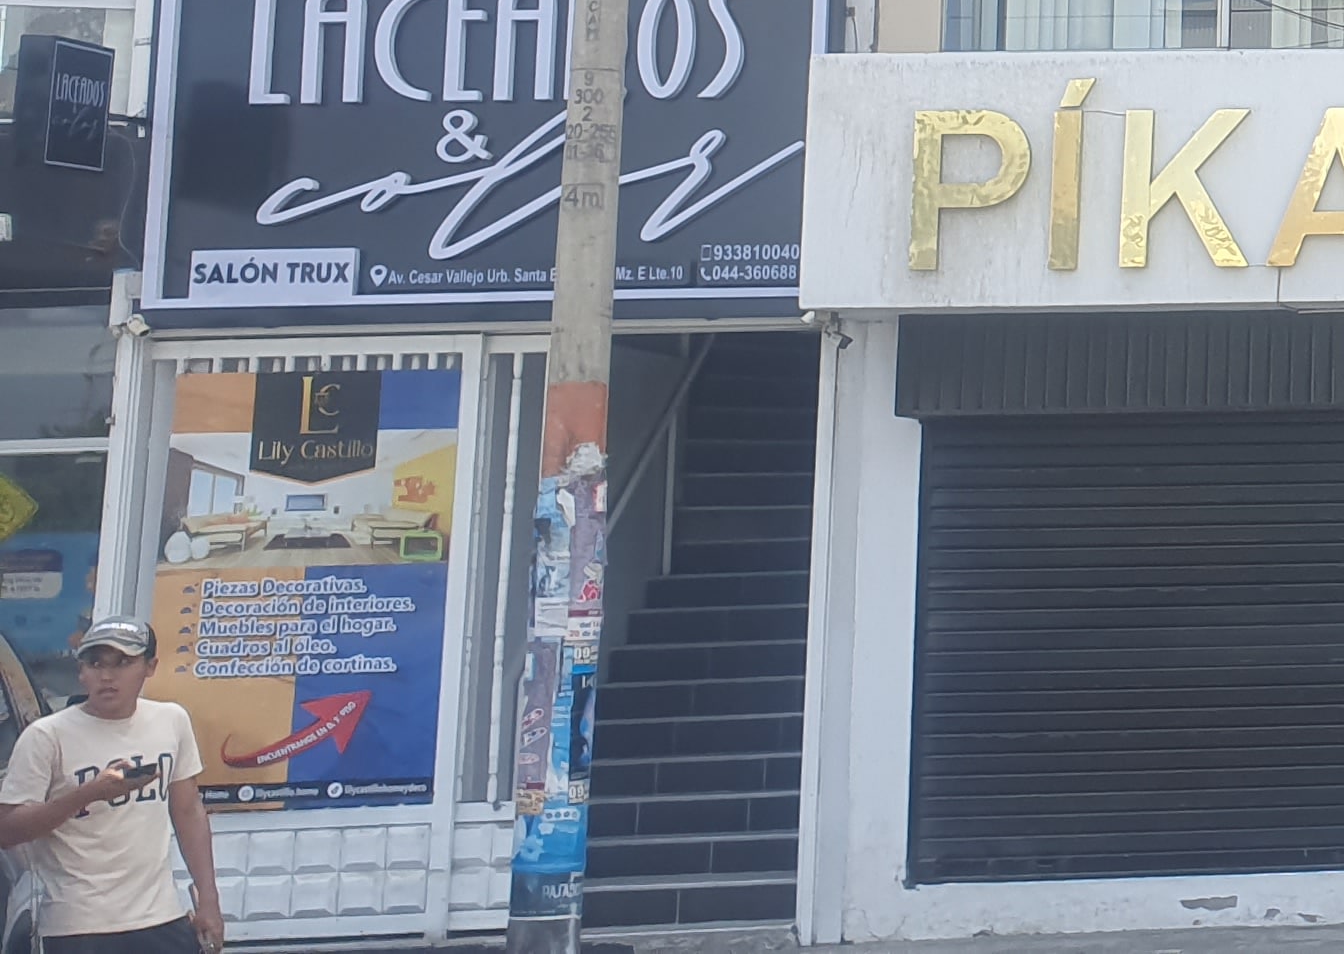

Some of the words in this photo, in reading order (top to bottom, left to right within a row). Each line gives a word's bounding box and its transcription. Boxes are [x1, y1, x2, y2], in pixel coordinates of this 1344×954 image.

[437, 111, 493, 163] &
[714, 245, 800, 261] 933810040
[193, 257, 278, 284] SALÓN
[287, 262, 350, 284] TRUX
[388, 270, 405, 285] Av.
[409, 269, 443, 284] Cesar
[445, 269, 484, 286] Vallejo
[487, 269, 510, 283] Urb.
[514, 267, 547, 282] Santa
[616, 266, 634, 280] Mz.
[712, 265, 797, 281] 044-360688
[259, 440, 294, 465] Lily
[301, 440, 374, 459] Castillo
[203, 580, 258, 596] Piezas
[262, 576, 367, 594] Decorativas.
[201, 598, 299, 615] Decoración
[302, 598, 326, 614] de
[329, 596, 416, 613] interiores.
[199, 620, 276, 637] Muebles
[277, 620, 317, 637] para
[320, 617, 338, 634] el
[340, 617, 396, 637] hogar.
[196, 639, 270, 656] Cuadros
[272, 639, 290, 654] al
[194, 658, 294, 677] Confección
[295, 657, 320, 674] de
[323, 655, 397, 673] cortinas.
